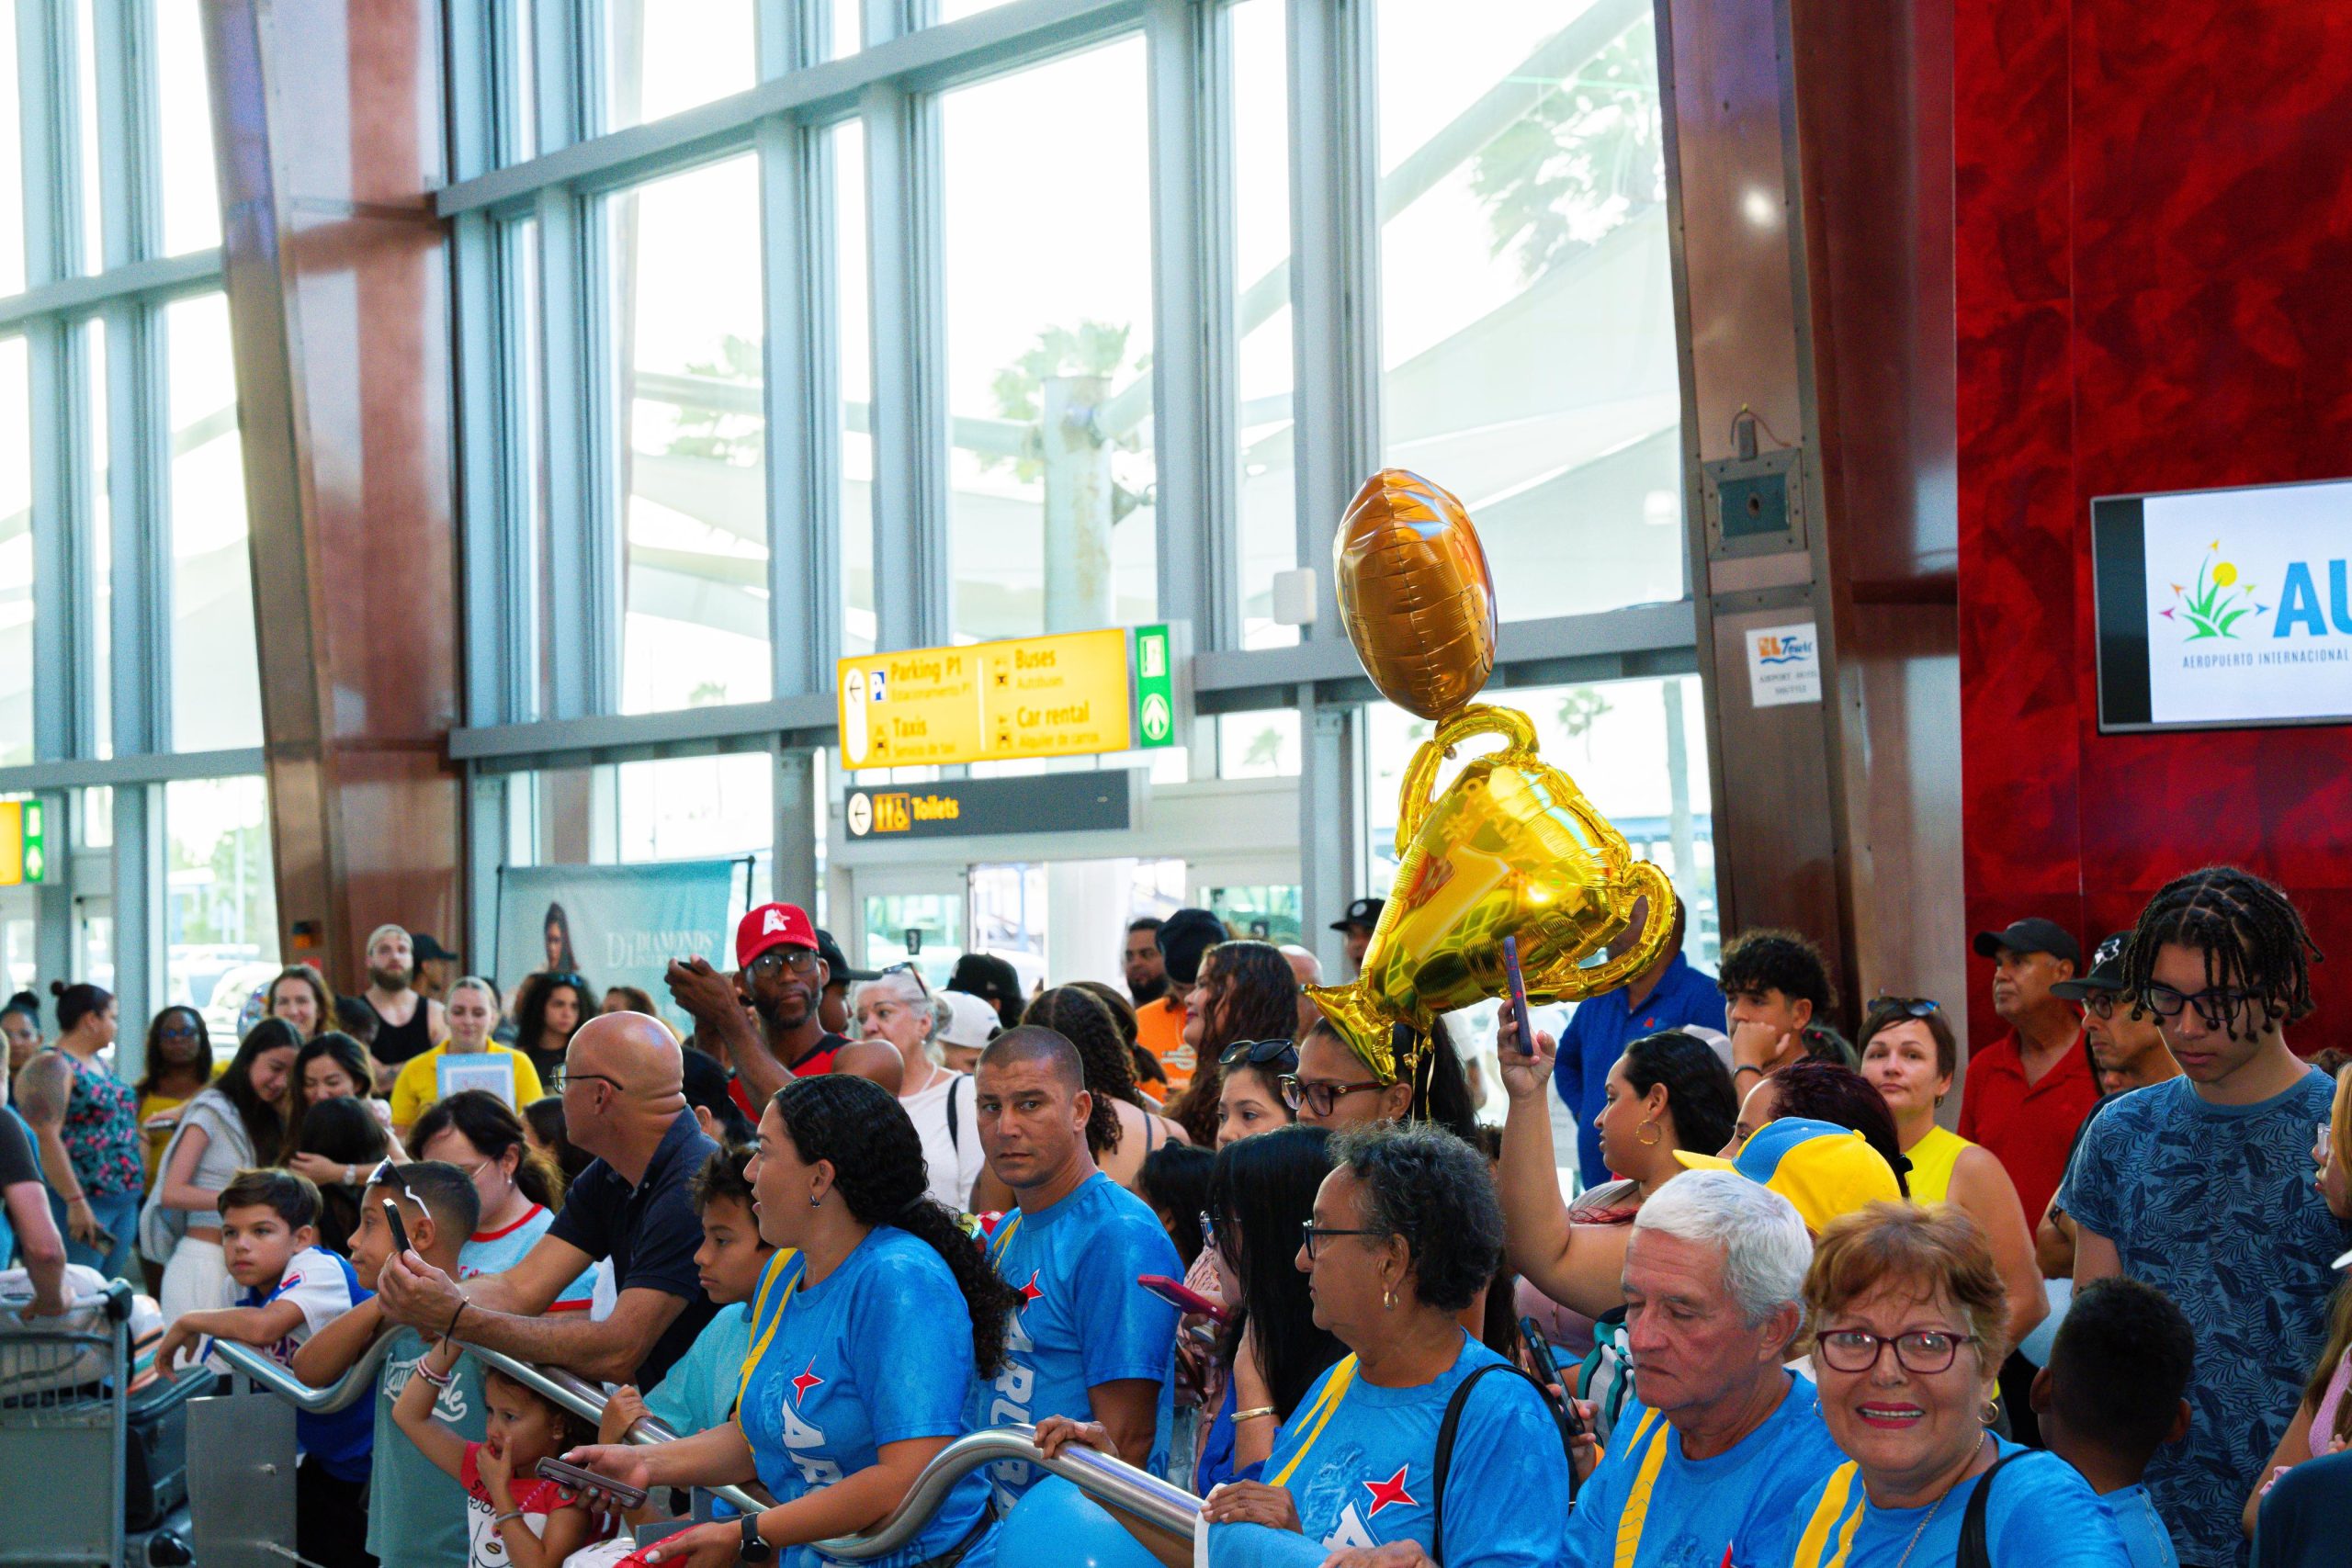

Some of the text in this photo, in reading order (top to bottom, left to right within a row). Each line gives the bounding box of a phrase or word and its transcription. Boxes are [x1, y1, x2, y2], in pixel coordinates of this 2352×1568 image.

[890, 656, 962, 684] Parking P1
[1014, 649, 1056, 669] Buses
[2182, 649, 2349, 669] AEROPUERTO INTERNACIONAL
[1016, 700, 1090, 728] Car rental
[892, 715, 927, 738] Taxis
[910, 795, 960, 820] Toilets
